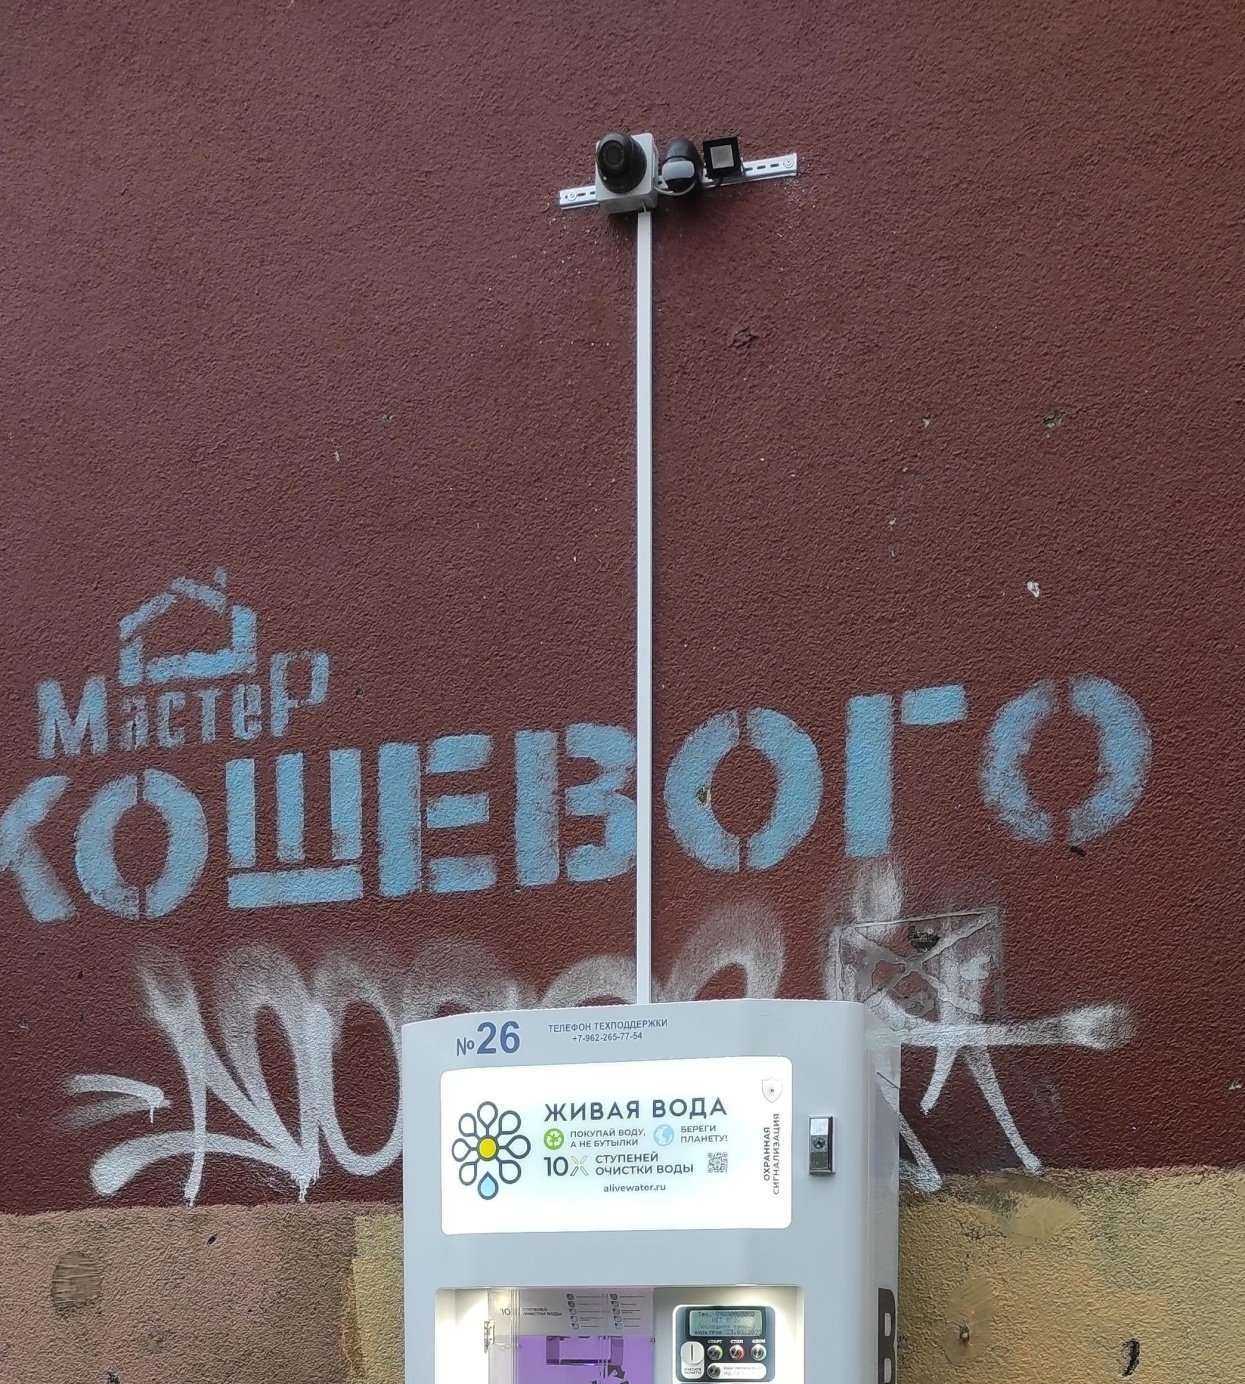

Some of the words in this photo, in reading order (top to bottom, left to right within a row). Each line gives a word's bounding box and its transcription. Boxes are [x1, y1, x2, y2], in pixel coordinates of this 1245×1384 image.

[0, 673, 1152, 923] КОШЕВОГО
[548, 1023, 592, 1033] ТЕЛЕФОН
[594, 1018, 669, 1031] ТЕХПОДДЕРЖКИ
[572, 1031, 643, 1043] +7-962-265-77-54
[544, 1101, 640, 1122] ЖИВАЯ
[652, 1097, 728, 1120] ВОДА
[570, 1128, 616, 1138] ПОКУПАЙ
[618, 1127, 646, 1138] ВОДУ,
[680, 1124, 717, 1133] БЕРЕГИ
[579, 1140, 592, 1148] НЕ
[593, 1139, 639, 1148] БУТЫЛКИ
[680, 1134, 728, 1144] ПЛАНЕТУ!
[595, 1151, 659, 1164] СТУПЕНЕЙ
[763, 1127, 771, 1182] ОХРАННАЯ
[772, 1113, 781, 1196] СИГНАЛИЗАЦИЯ
[595, 1165, 653, 1176] ОЧИСТКИ
[656, 1164, 694, 1176] ВОДЫ
[603, 1183, 667, 1193] alivewater.ru
